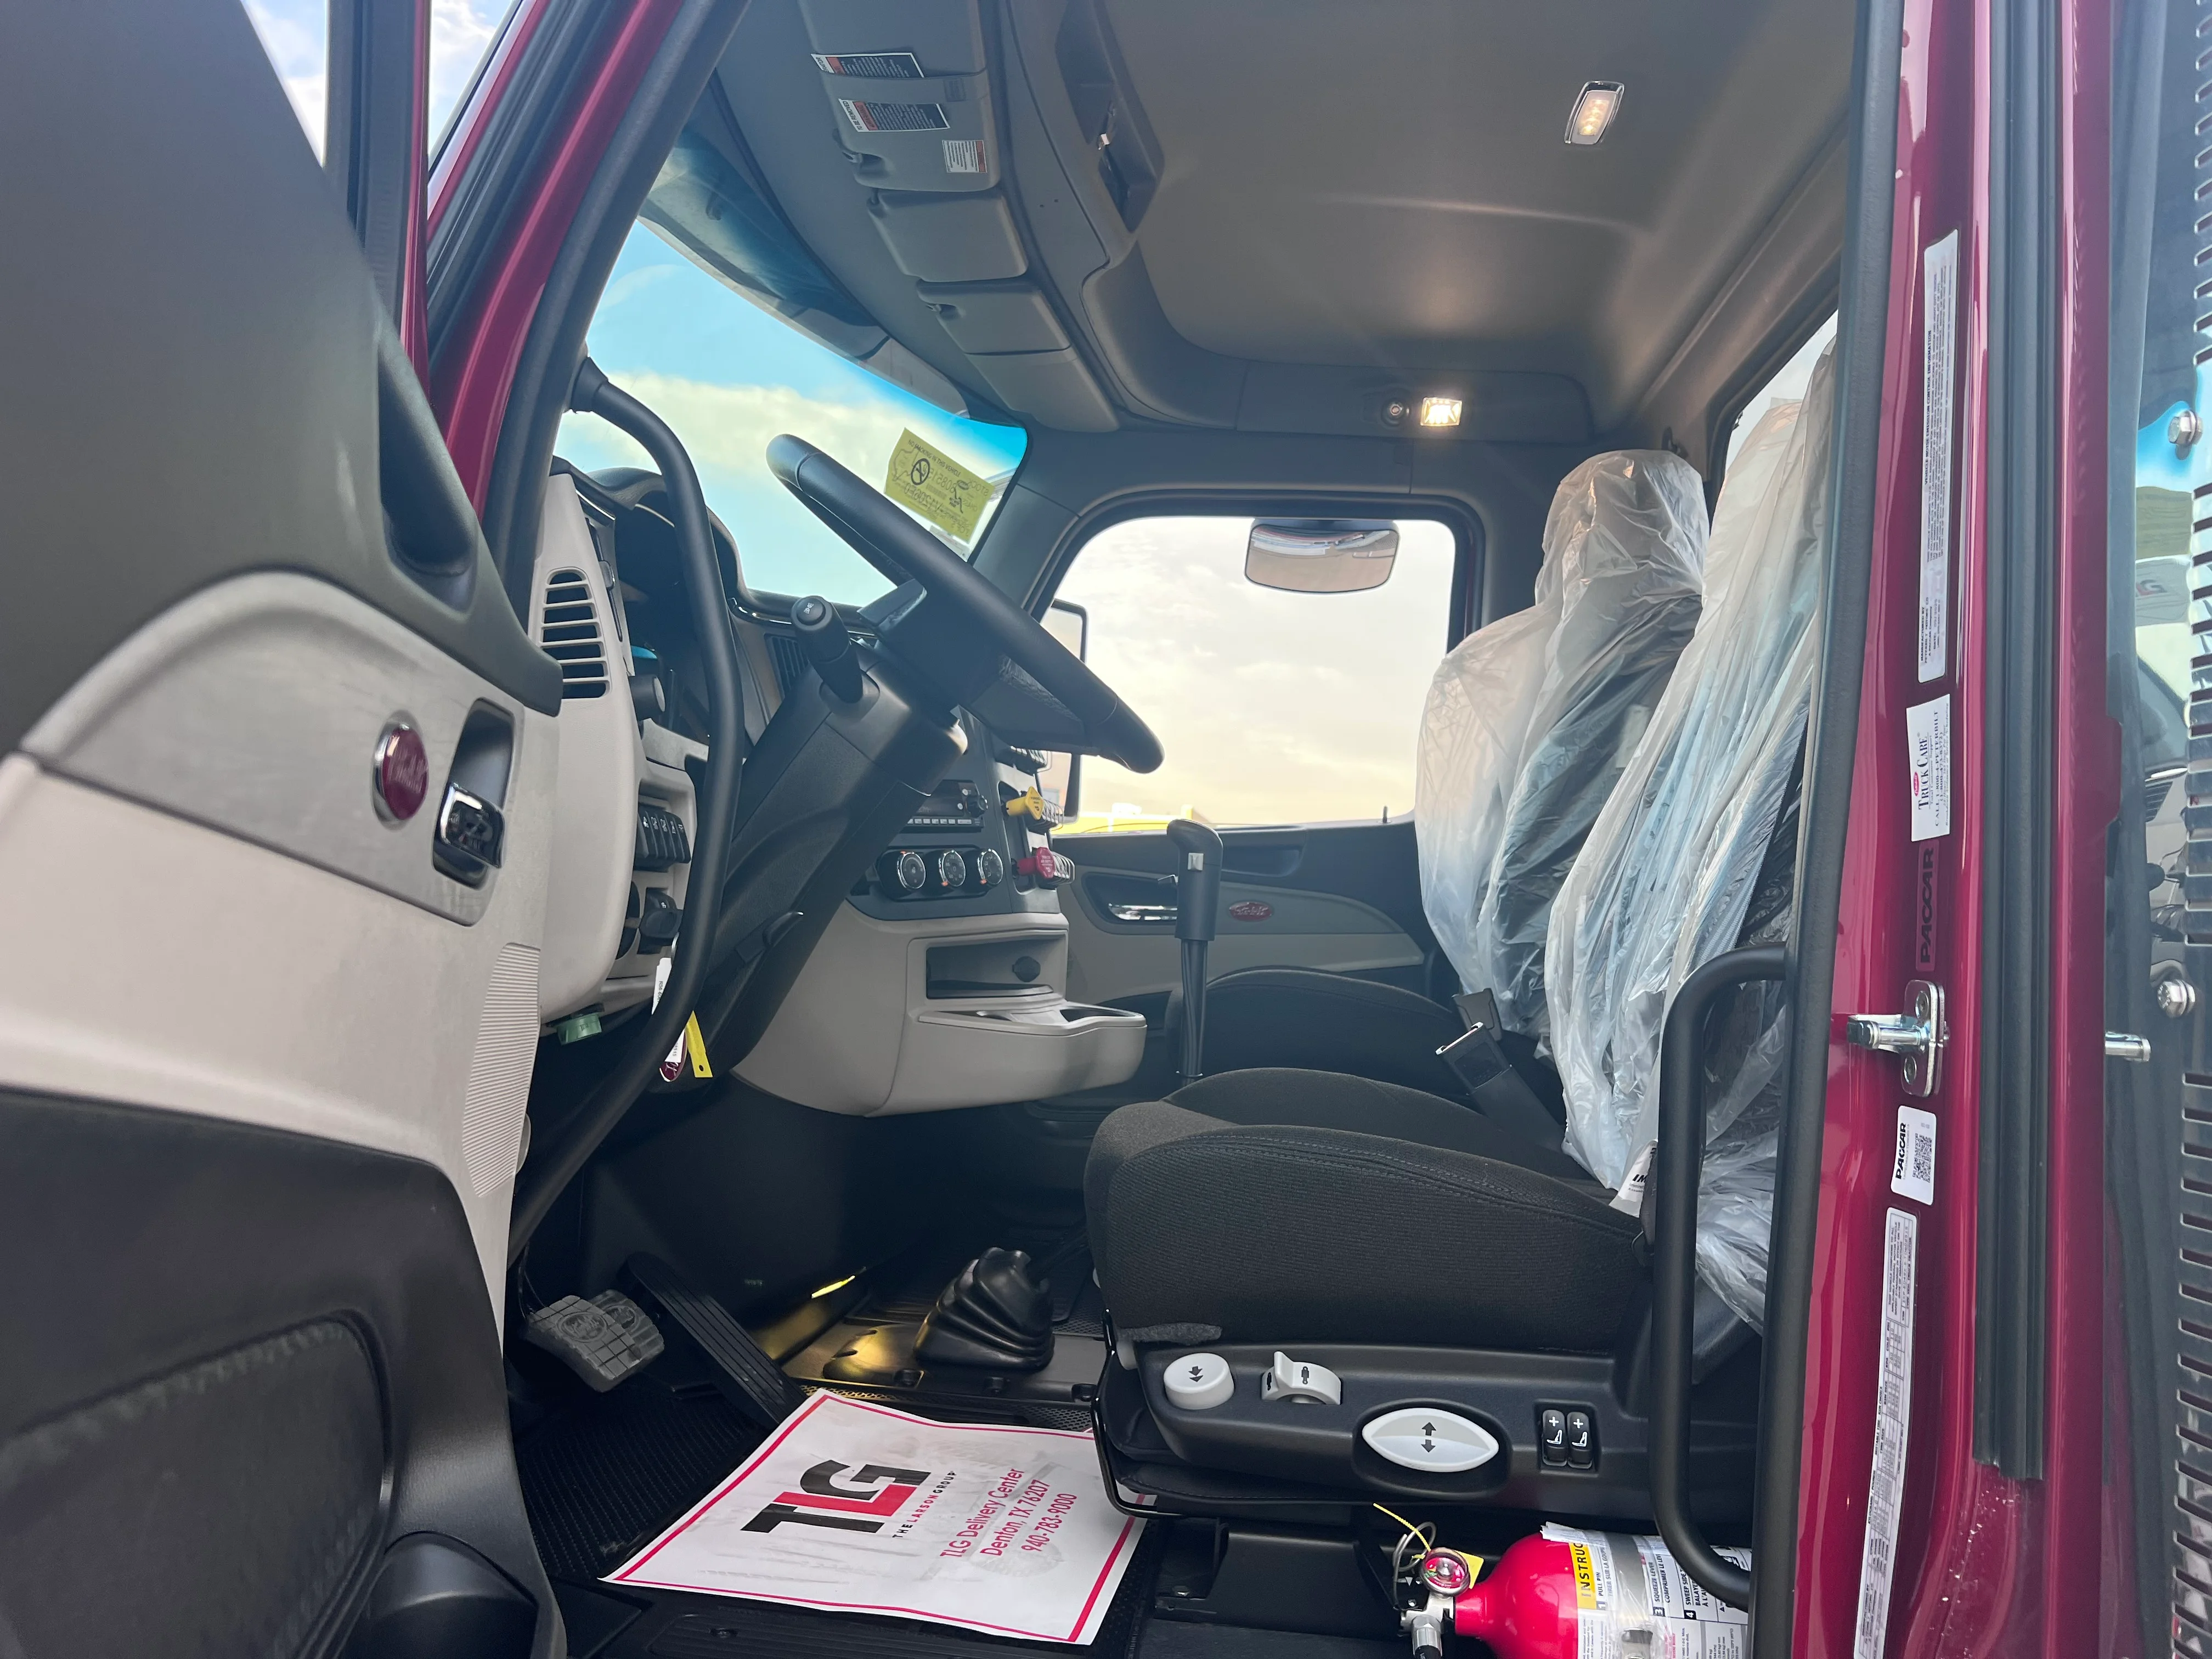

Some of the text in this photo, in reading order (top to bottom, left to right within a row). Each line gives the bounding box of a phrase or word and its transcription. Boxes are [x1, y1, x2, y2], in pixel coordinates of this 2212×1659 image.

[843, 101, 857, 120] REMOVED
[908, 439, 914, 447] NO
[945, 464, 962, 477] VEHICLE
[1917, 737, 1929, 810] TRUCK CARE
[1920, 847, 1934, 963] PACCAR
[1895, 1122, 1906, 1180] PACCAR
[740, 1459, 932, 1534] TLG
[892, 1471, 957, 1538] THE LARSON GROUP
[940, 1468, 1025, 1558] TLG Delivery Center
[980, 1479, 1051, 1556] Denton, TX 76207
[1021, 1493, 1077, 1552] 940-783-9000
[1652, 1578, 1660, 1602] SQUEEZE
[1660, 1570, 1671, 1602] COMPRIMER
